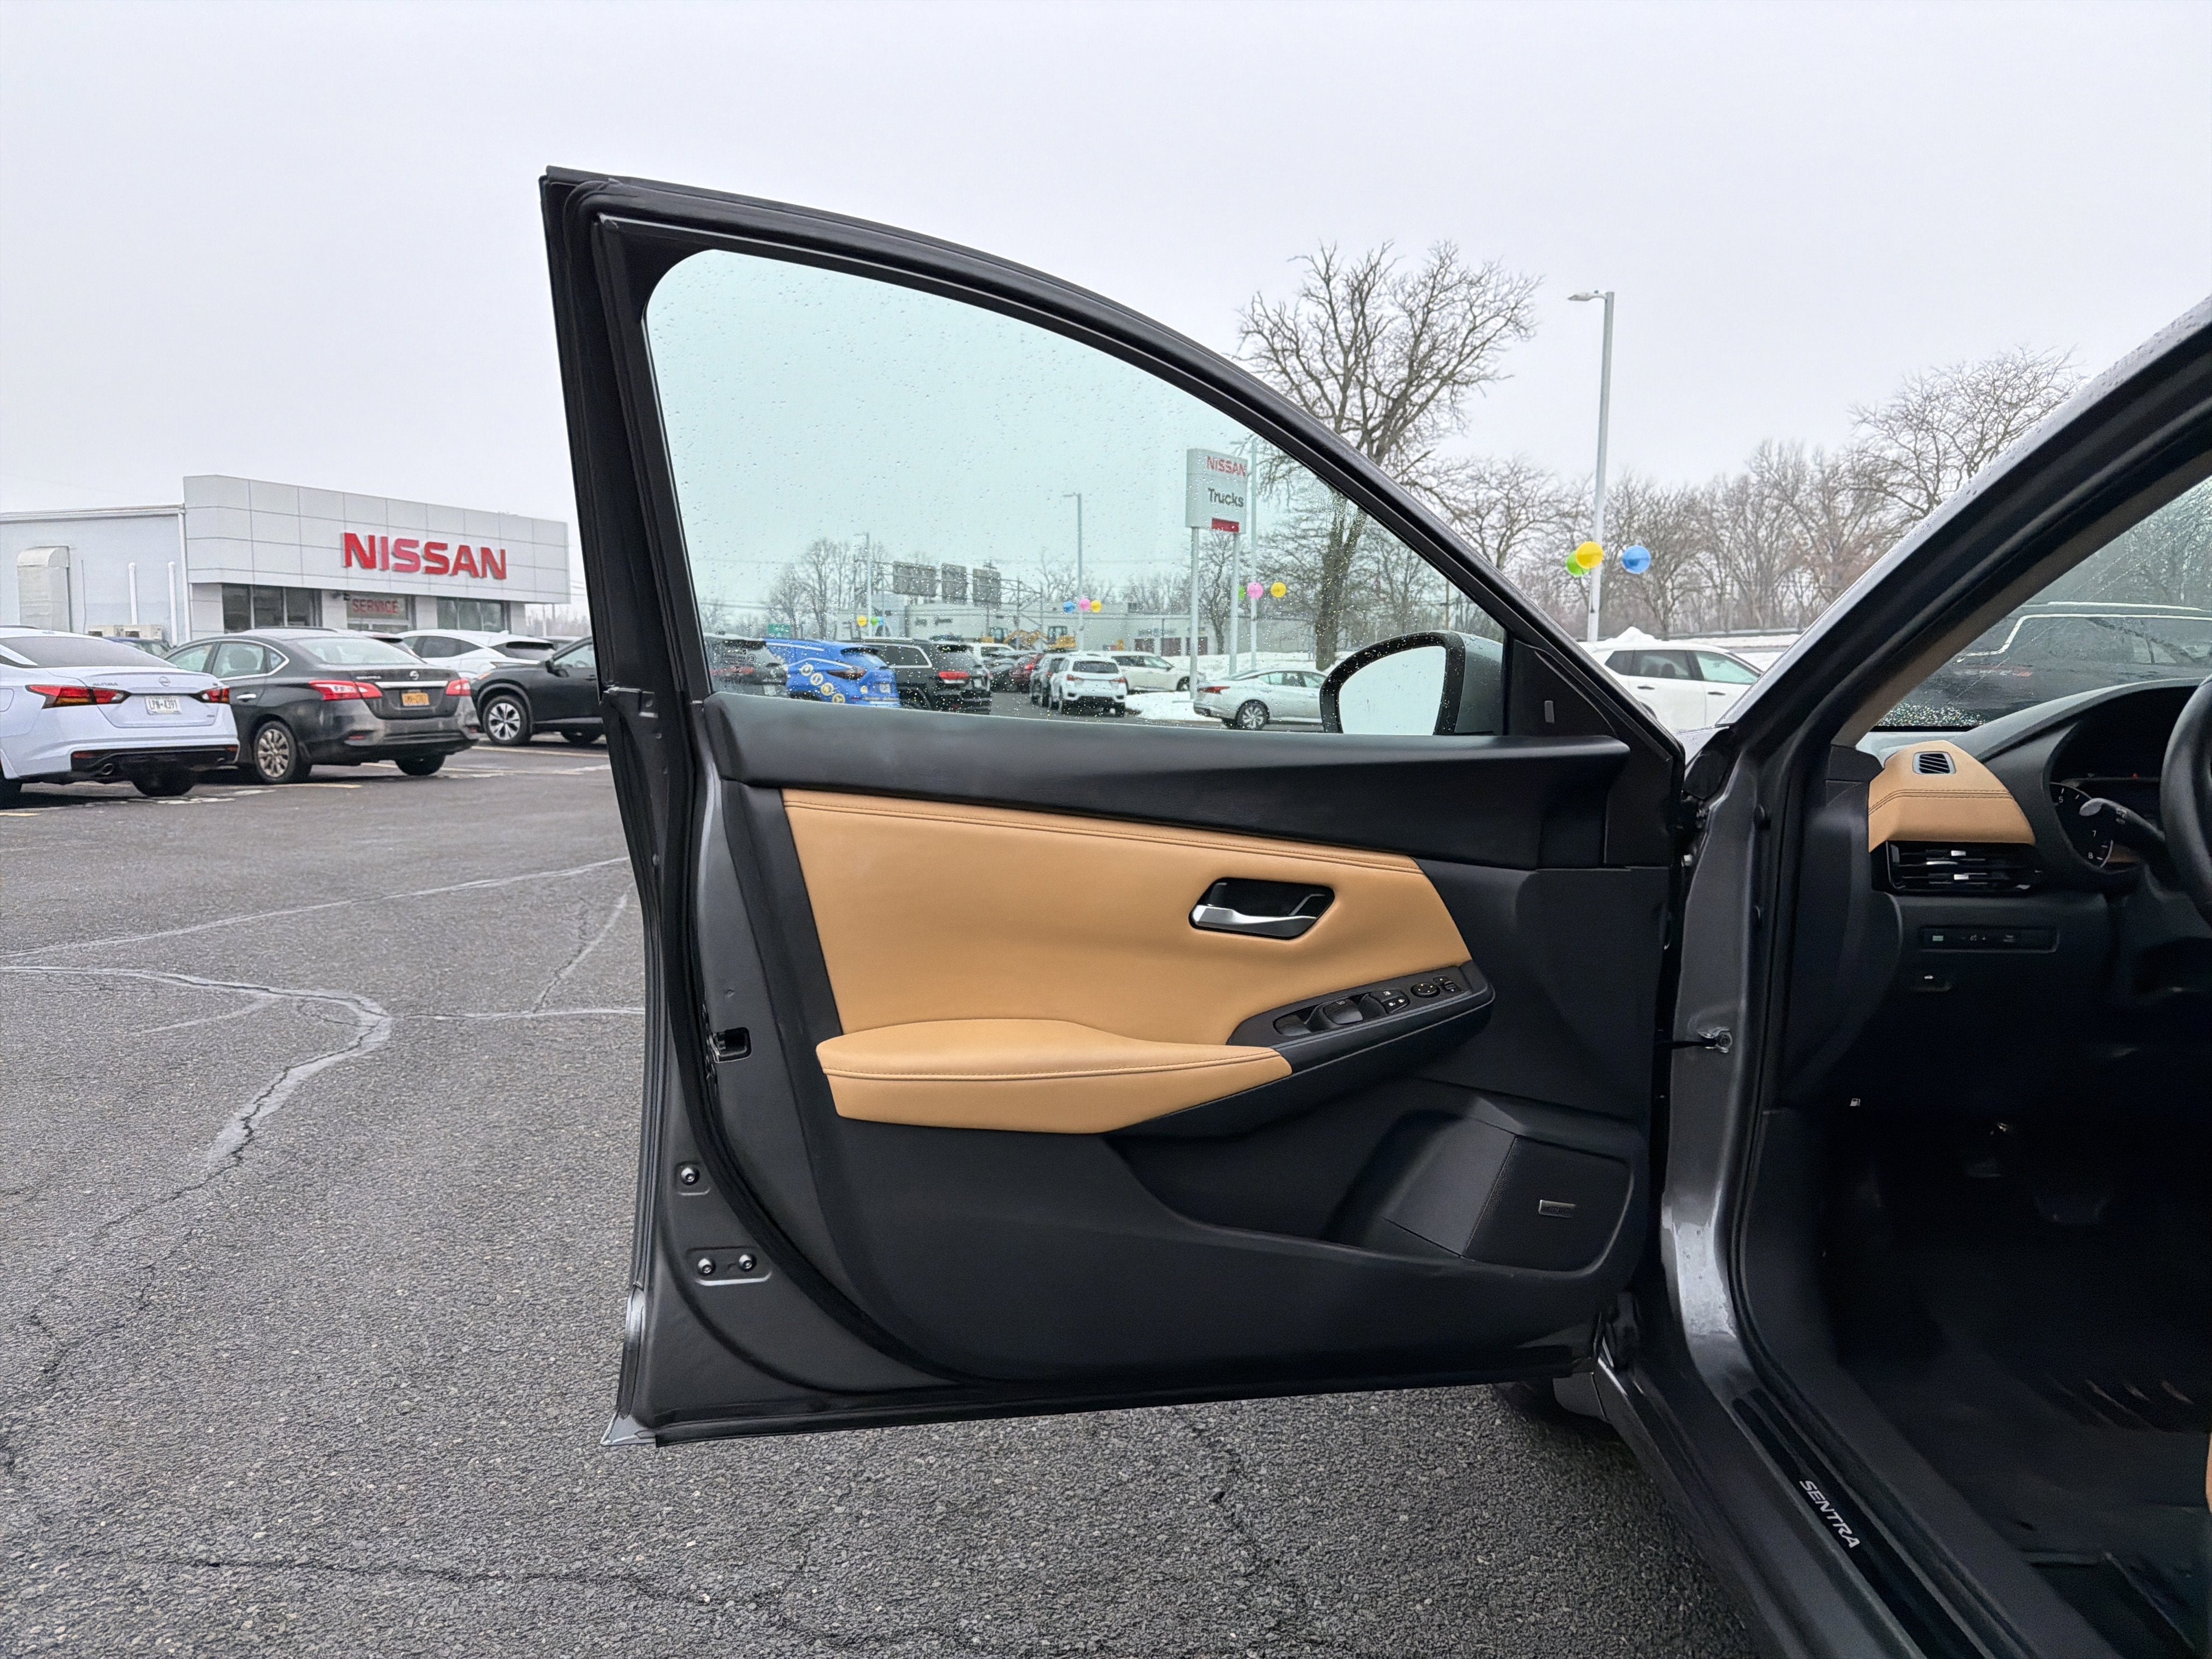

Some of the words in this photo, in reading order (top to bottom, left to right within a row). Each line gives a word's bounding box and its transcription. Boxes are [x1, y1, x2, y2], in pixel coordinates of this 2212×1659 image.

[1207, 455, 1246, 477] NISSAN
[1207, 487, 1244, 507] Trucks
[343, 532, 507, 580] NISSAN
[352, 599, 399, 614] SERVICE
[1799, 1480, 1860, 1548] SENTRA
